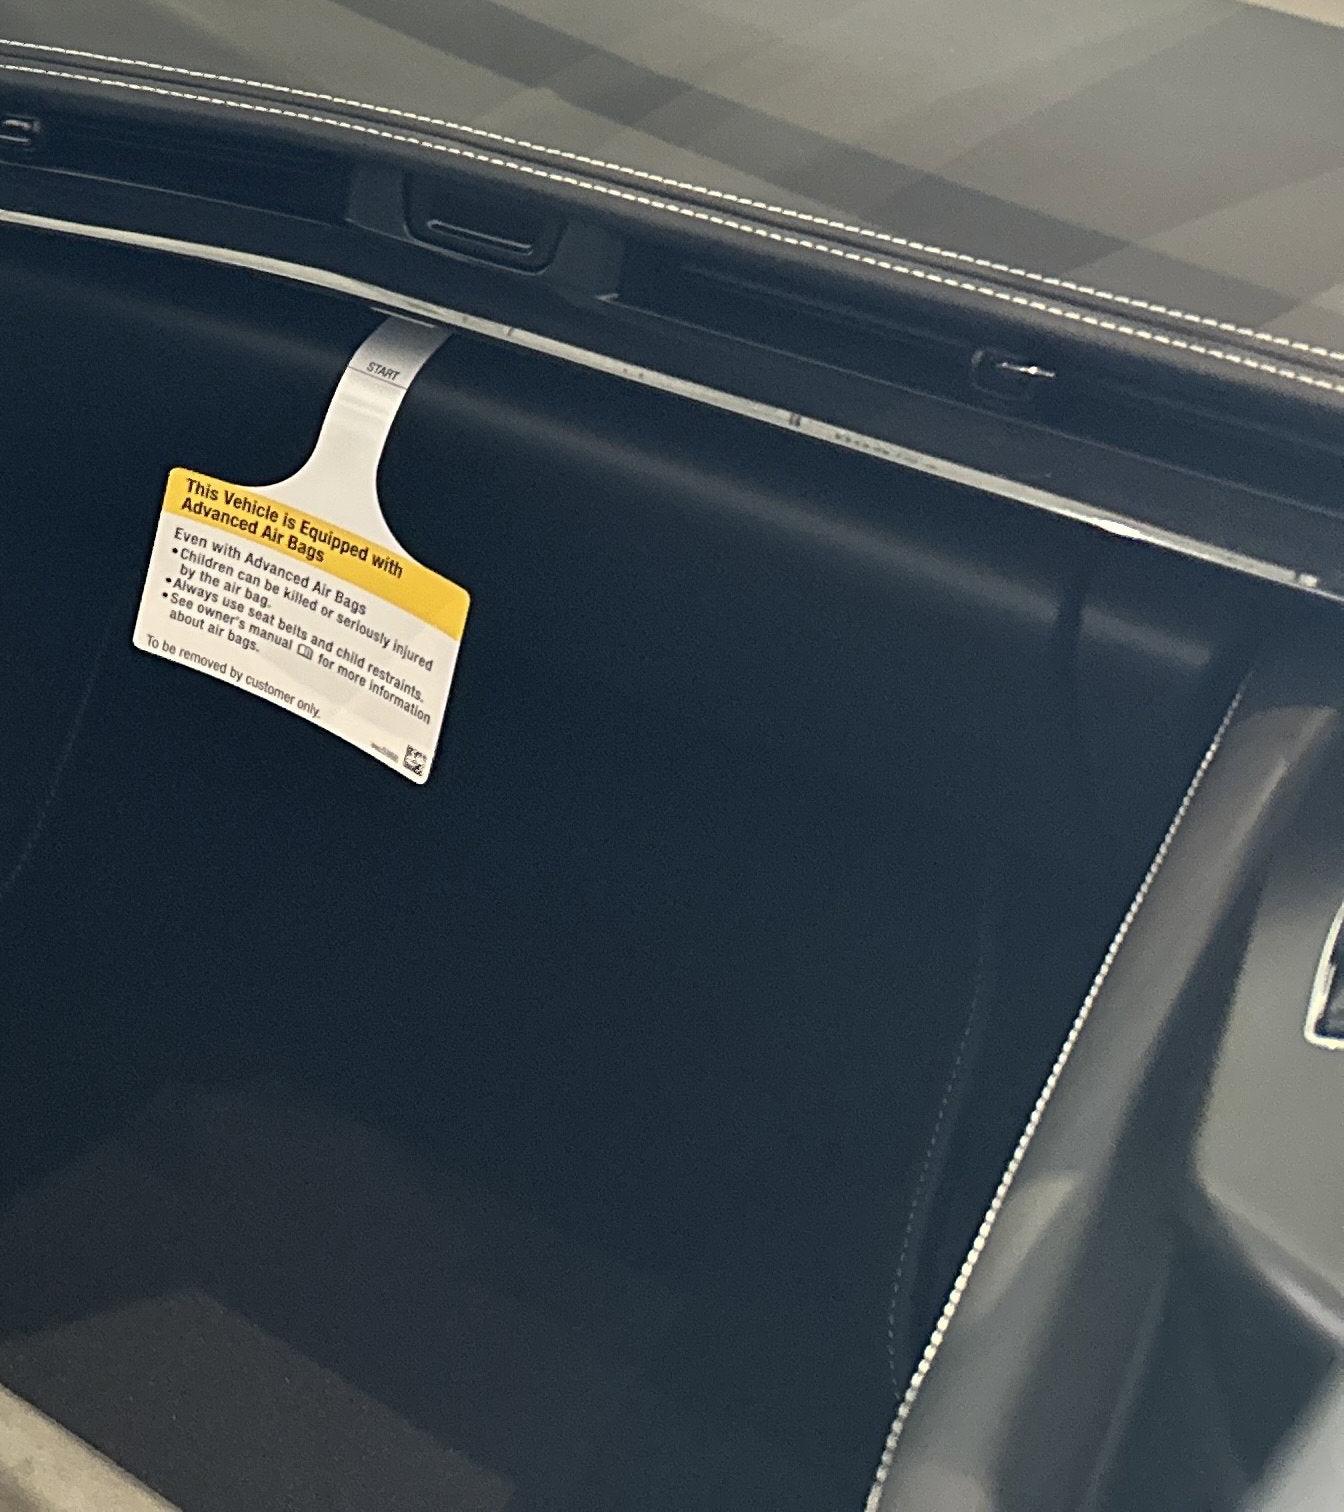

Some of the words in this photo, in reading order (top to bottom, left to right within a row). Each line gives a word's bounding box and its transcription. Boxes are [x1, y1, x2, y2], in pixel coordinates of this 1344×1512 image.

[366, 362, 400, 380] START
[174, 527, 208, 548] Even
[212, 540, 241, 560] with
[245, 553, 310, 588] Advanced
[312, 581, 332, 598] Air
[335, 590, 367, 615] Bags
[181, 498, 260, 535] Advanced
[262, 526, 284, 544] Air
[287, 535, 325, 563] Bags
[187, 478, 219, 501] This
[224, 490, 278, 522] Vehicle
[282, 512, 296, 529] is
[300, 521, 369, 562] Equipped
[372, 555, 404, 579] with
[180, 564, 195, 580] by
[199, 570, 220, 587] the
[223, 579, 243, 593] air
[245, 587, 272, 608] bag.
[180, 547, 234, 577] Children
[238, 570, 261, 588] can
[264, 579, 280, 595] be
[284, 587, 318, 611] killed
[321, 606, 333, 619] or
[336, 612, 391, 649] seriously
[392, 639, 433, 672] injured
[169, 609, 205, 630] about
[207, 623, 225, 637] air
[227, 629, 260, 653] bags.
[170, 593, 193, 610] See
[197, 603, 246, 629] owner's
[249, 624, 293, 650] manual
[318, 654, 335, 670] for
[337, 664, 366, 687] more
[369, 680, 431, 725] information
[173, 577, 219, 603] Always
[222, 596, 244, 612] use
[249, 607, 275, 626] seat
[278, 618, 308, 641] belts
[311, 634, 334, 653] and
[336, 646, 365, 668] child
[368, 664, 425, 703] restraints.
[147, 634, 159, 649] To
[162, 640, 176, 655] be
[179, 648, 228, 674] removed
[230, 666, 243, 682] by
[245, 675, 295, 705] customer
[297, 700, 321, 719] only.
